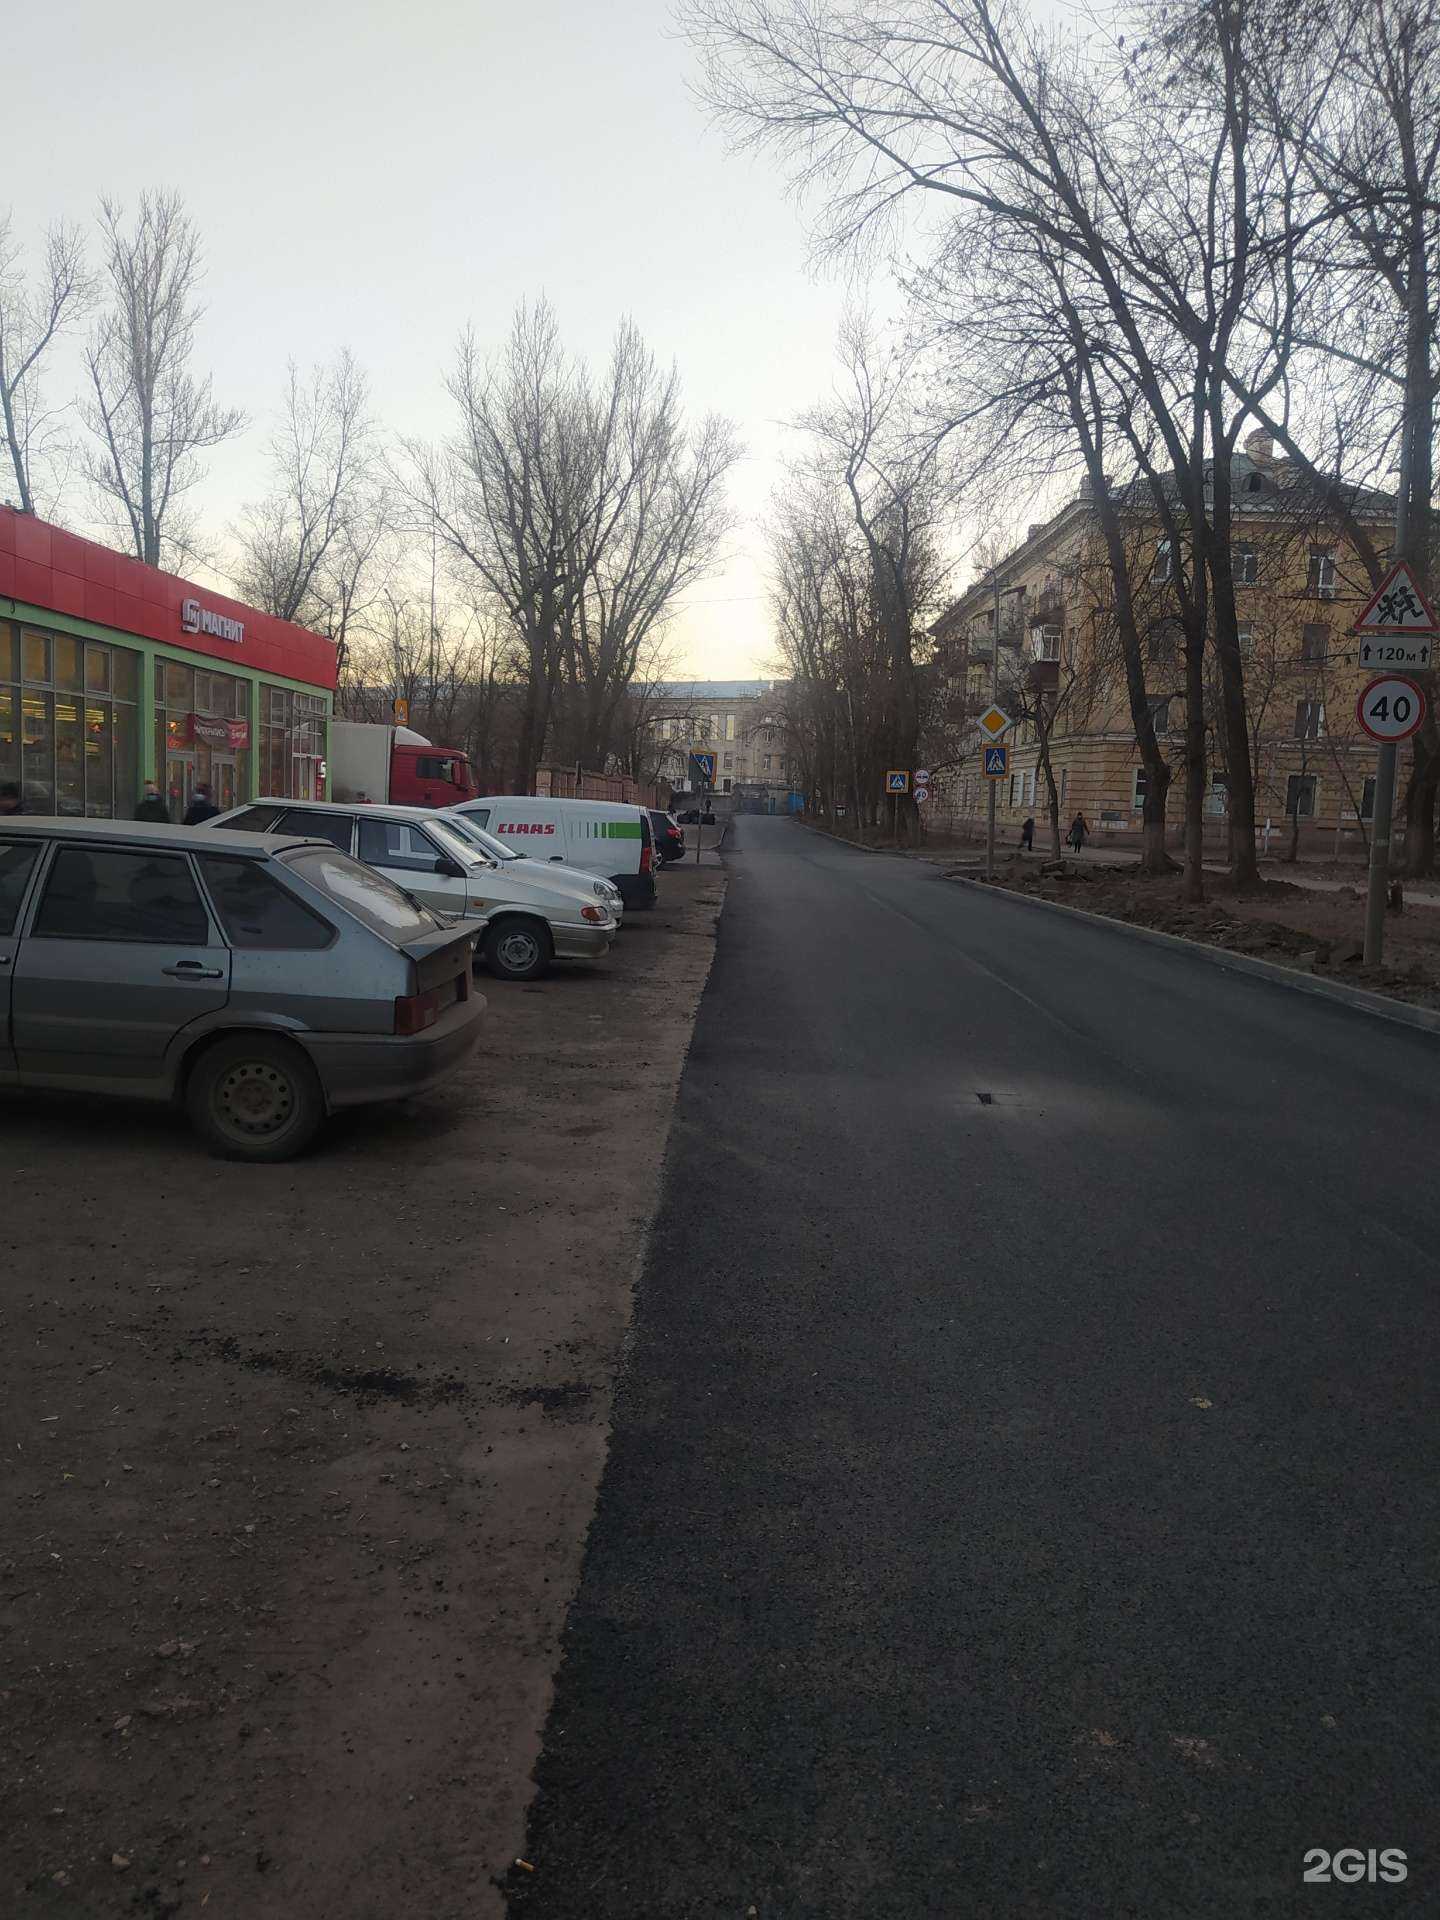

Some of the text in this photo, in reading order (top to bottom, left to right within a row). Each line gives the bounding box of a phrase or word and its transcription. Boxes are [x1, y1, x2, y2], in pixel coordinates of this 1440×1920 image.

[202, 608, 245, 643] МАГНИТ
[1370, 696, 1411, 723] 40
[497, 823, 555, 835] CLAAS
